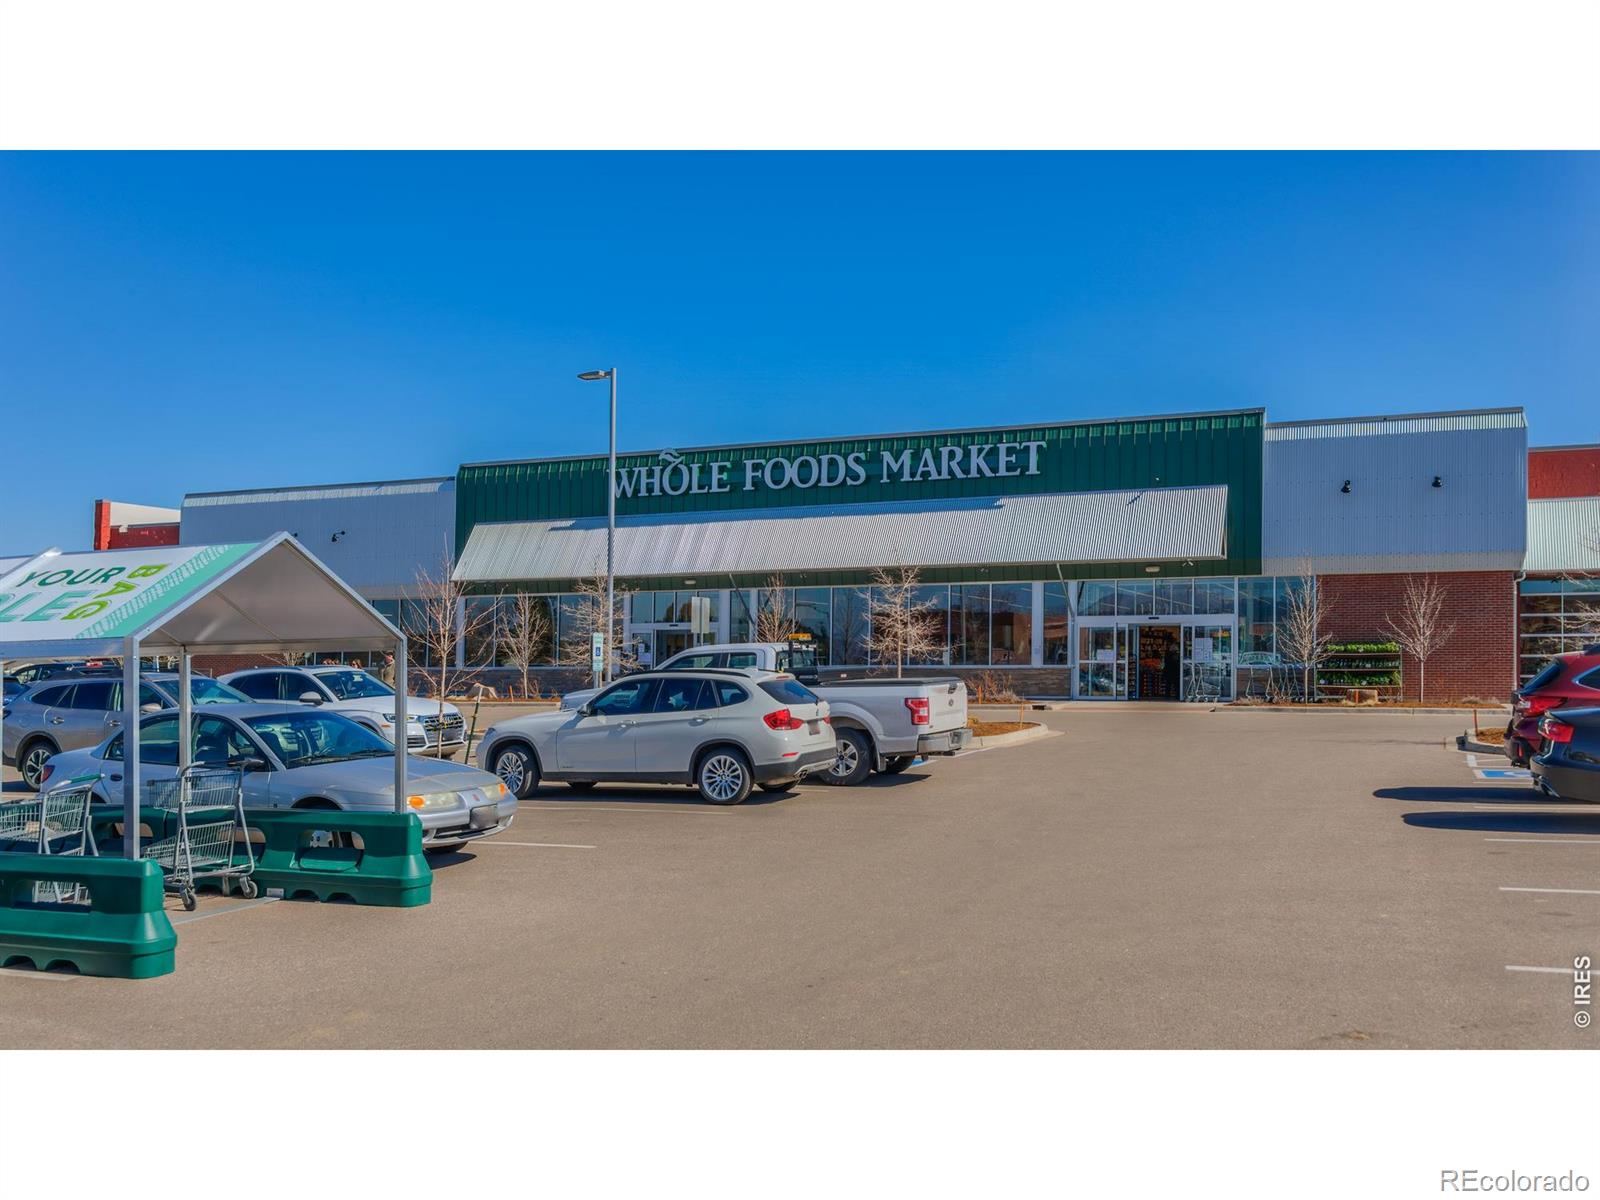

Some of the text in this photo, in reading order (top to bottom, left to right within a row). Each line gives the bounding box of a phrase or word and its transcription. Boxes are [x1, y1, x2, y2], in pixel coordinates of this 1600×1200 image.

[607, 441, 1047, 498] WHOLE FOODS MARKET
[17, 566, 127, 587] YOUR
[60, 563, 167, 620] BAG
[0, 590, 92, 622] LE
